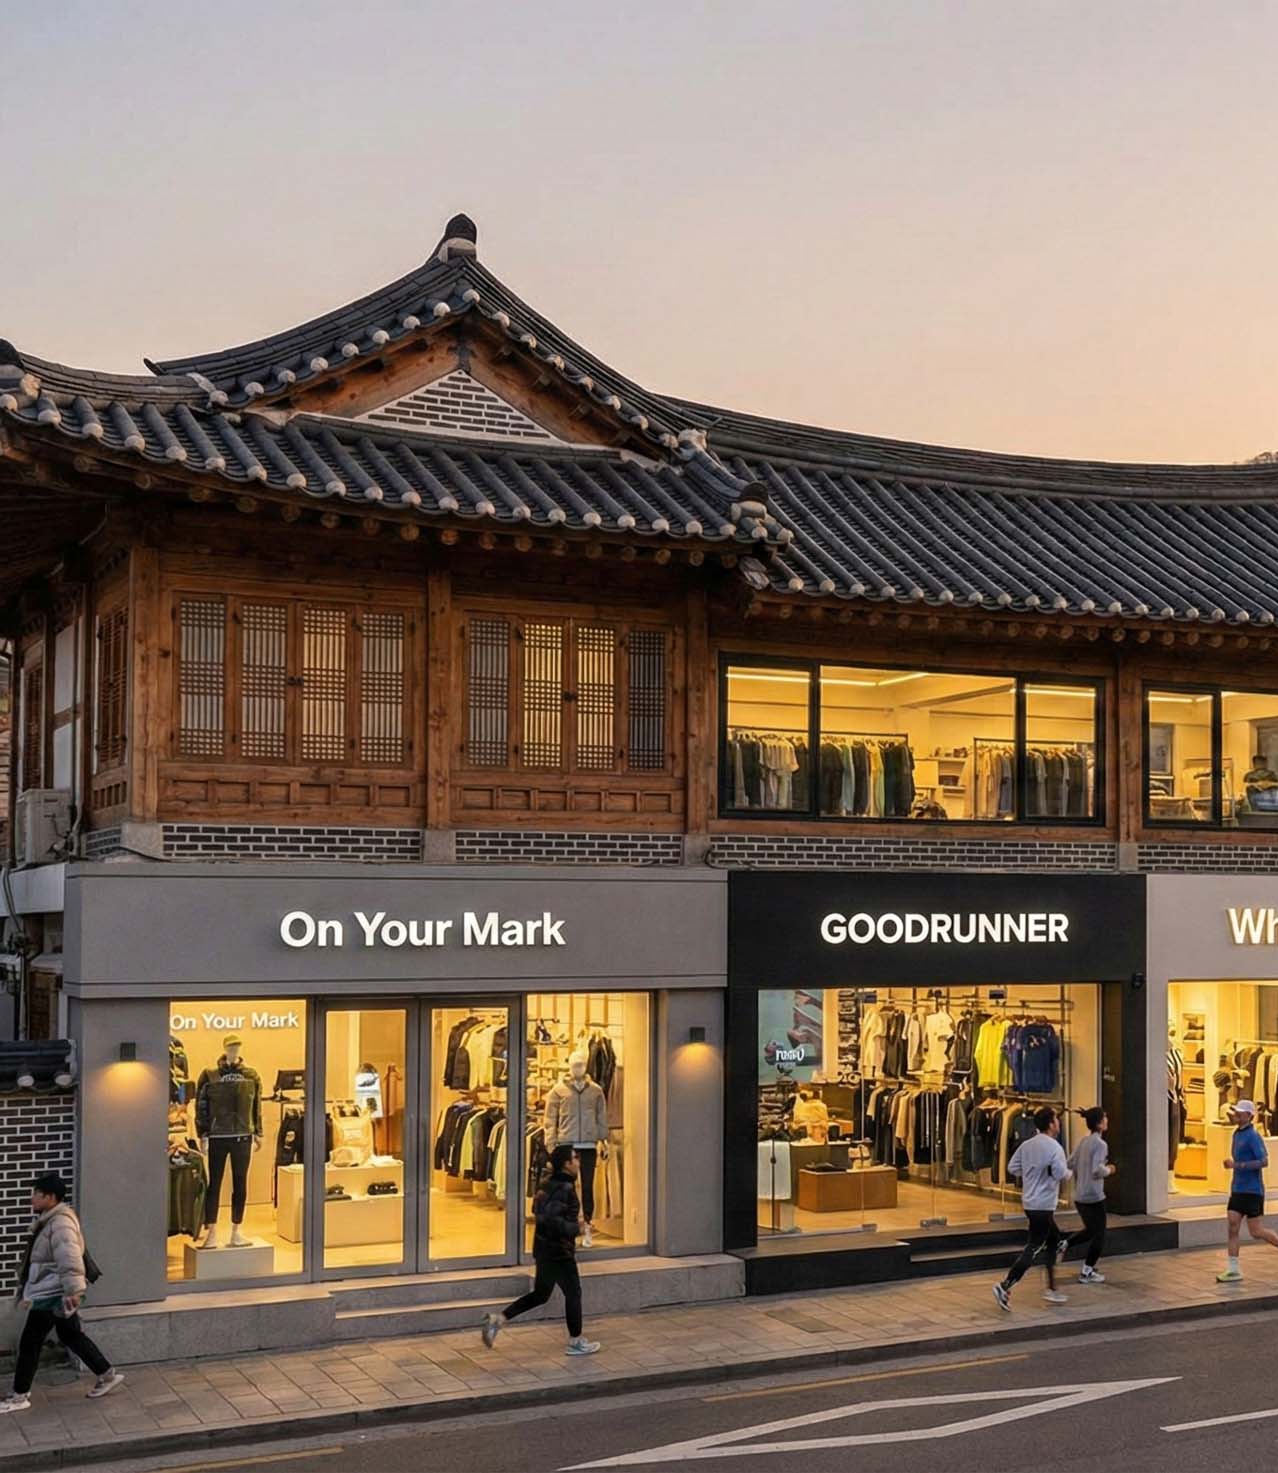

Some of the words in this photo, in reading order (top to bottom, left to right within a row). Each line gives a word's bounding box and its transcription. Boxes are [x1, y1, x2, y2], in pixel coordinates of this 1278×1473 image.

[280, 910, 344, 947] On
[353, 911, 453, 947] Your
[463, 911, 567, 946] Mark
[820, 912, 1070, 944] GOODRUNNER
[170, 1015, 197, 1030] On
[202, 1013, 245, 1029] Your
[252, 1011, 299, 1028] Mark
